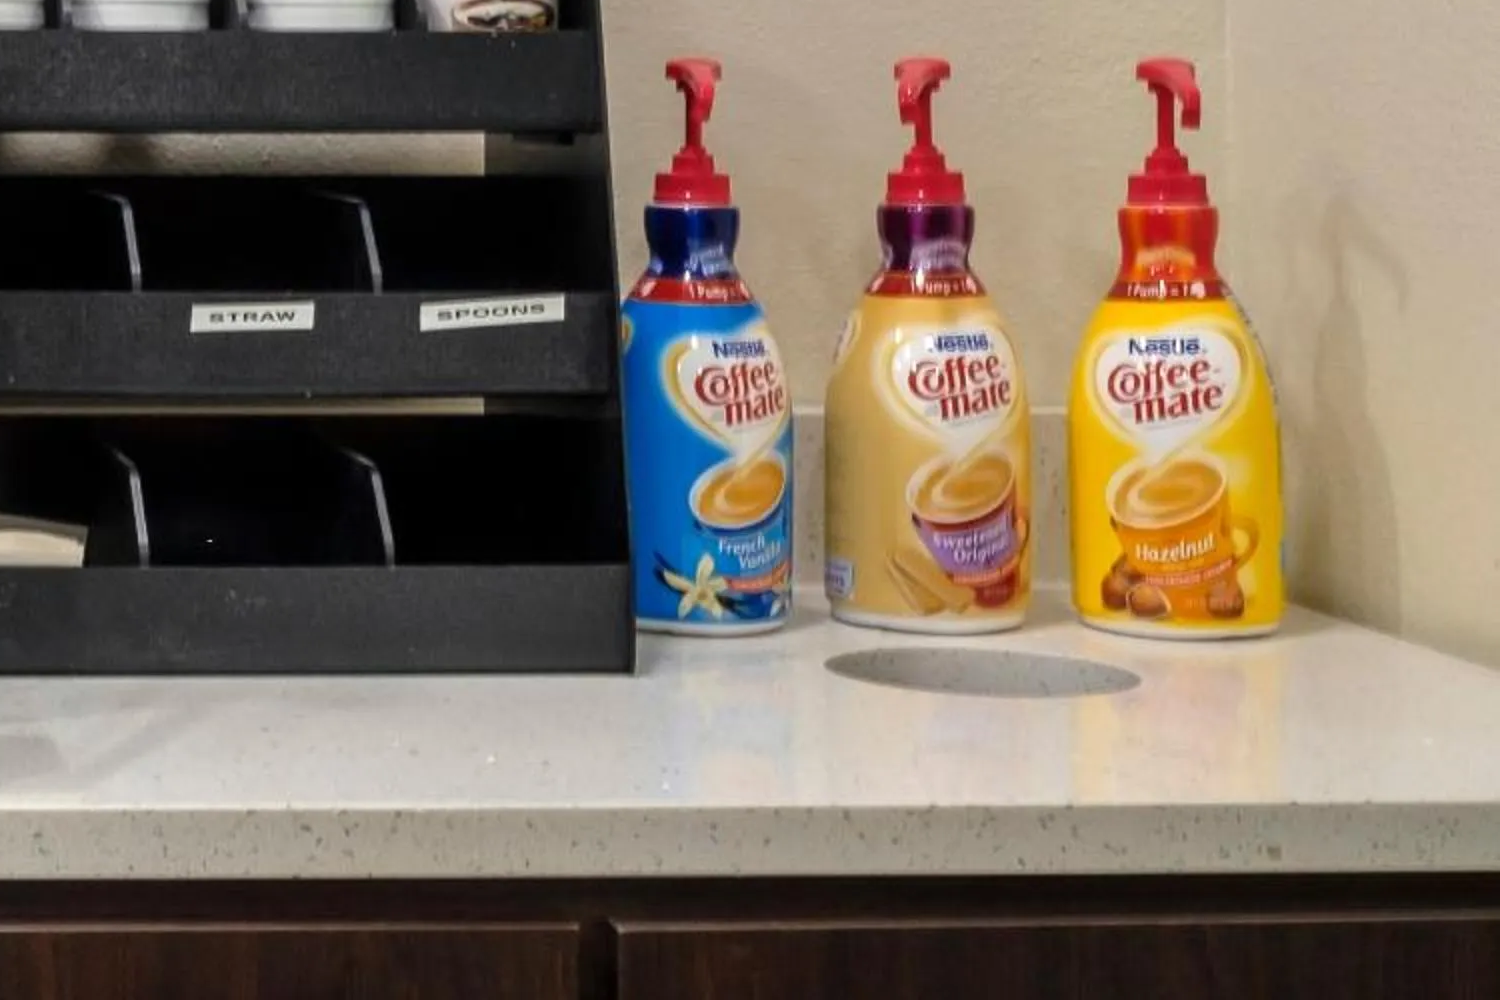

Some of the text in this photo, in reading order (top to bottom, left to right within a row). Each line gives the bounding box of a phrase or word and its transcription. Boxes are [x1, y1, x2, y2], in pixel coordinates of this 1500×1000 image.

[209, 310, 296, 323] STRAW
[437, 302, 547, 321] SPOONS
[725, 386, 784, 426] mate
[940, 379, 1011, 420] mate
[1133, 384, 1223, 424] mate
[1135, 531, 1214, 563] Hazelnut
